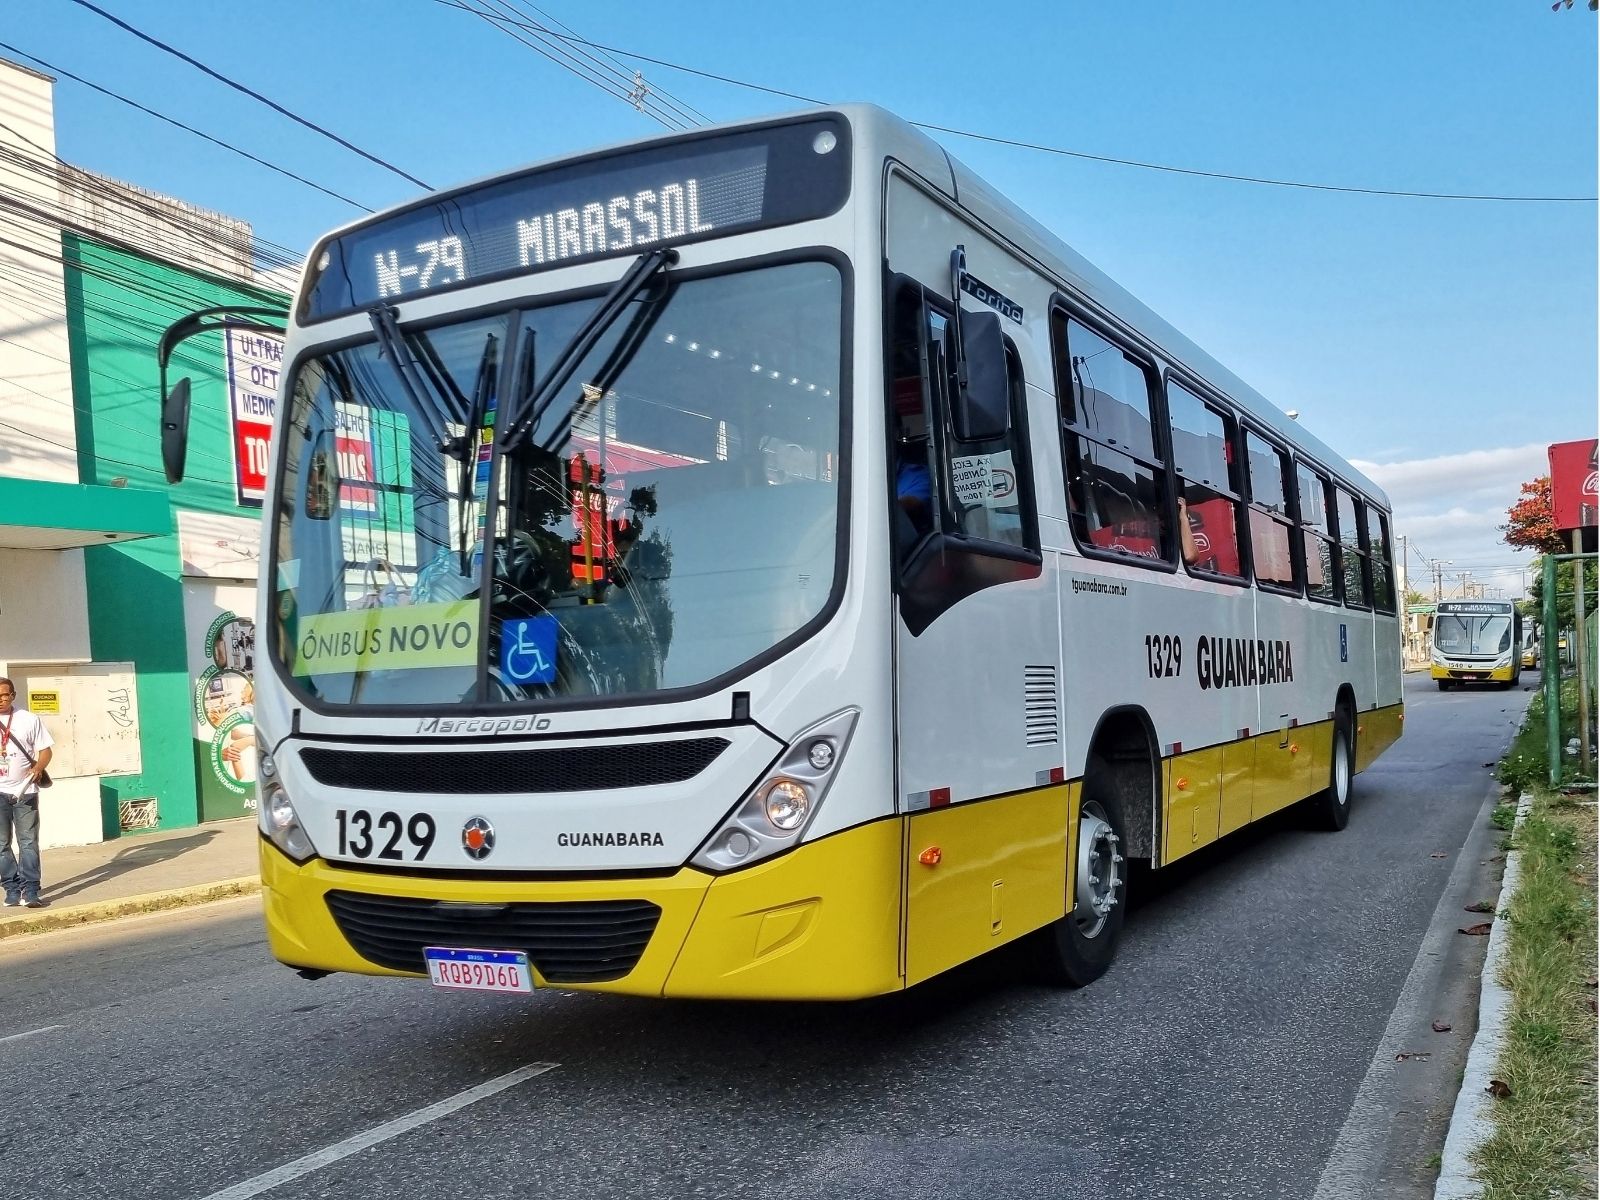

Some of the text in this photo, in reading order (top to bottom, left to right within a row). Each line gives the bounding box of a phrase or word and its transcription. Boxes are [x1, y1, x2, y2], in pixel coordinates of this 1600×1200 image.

[374, 178, 713, 298] N-79 MIRASSOL
[965, 276, 1021, 321] Torino
[245, 437, 271, 476] TO
[1072, 577, 1128, 596] tguanabara.com.br
[206, 611, 236, 658] OFTALMOLOGISTA
[302, 621, 472, 660] ÔNIBUS NOVO
[1144, 634, 1294, 690] 1329 GUANABARA
[416, 715, 552, 735] Marcopolo
[335, 809, 437, 862] 1329
[557, 832, 665, 847] GUANABARA
[438, 961, 520, 987] RQB9D60
